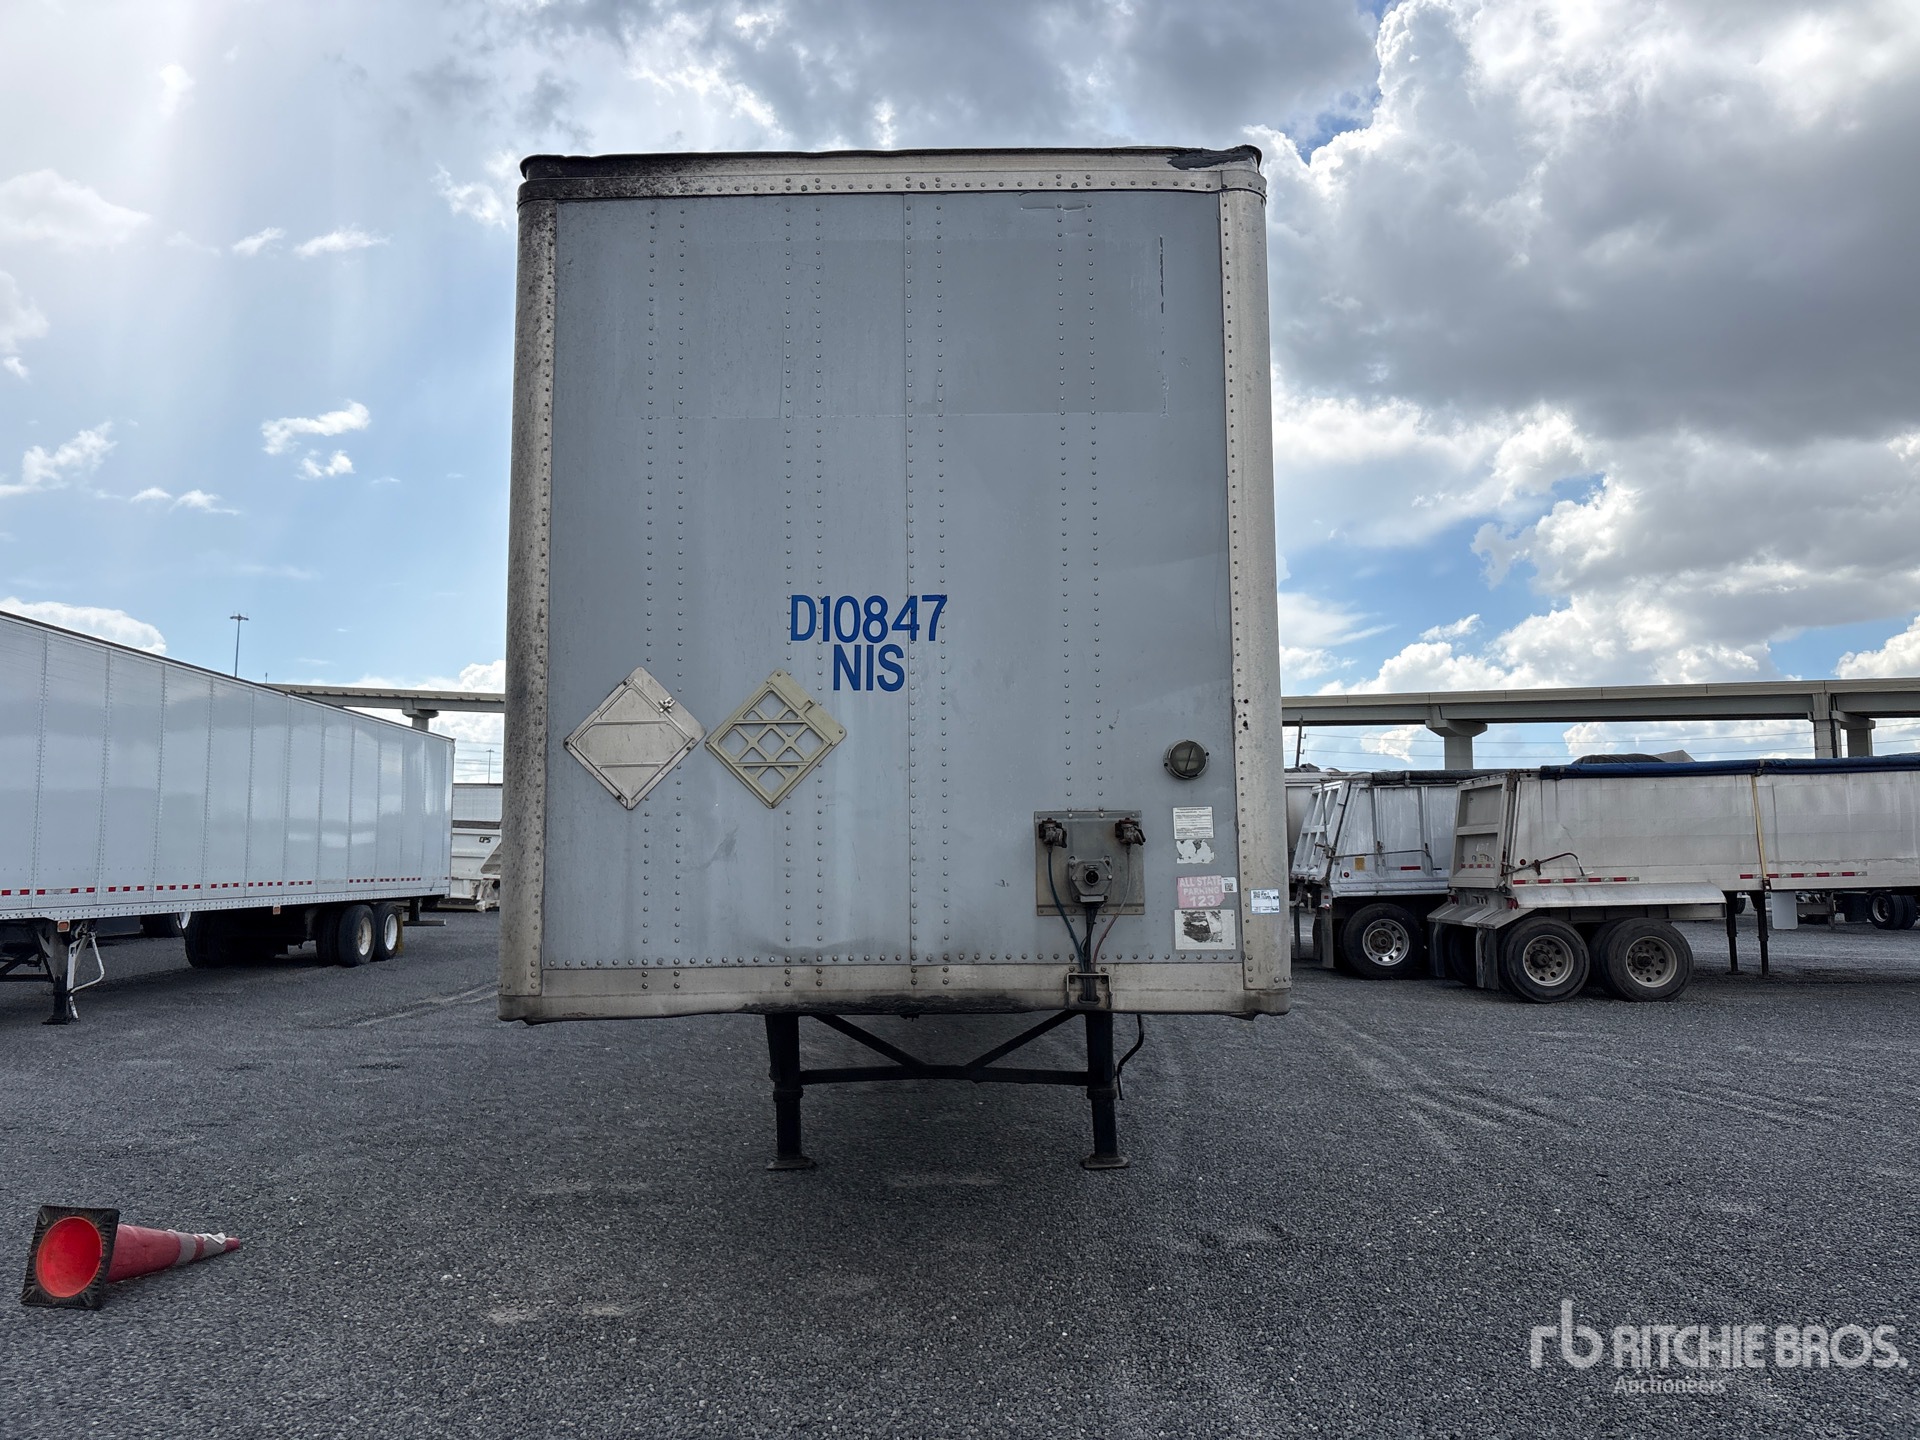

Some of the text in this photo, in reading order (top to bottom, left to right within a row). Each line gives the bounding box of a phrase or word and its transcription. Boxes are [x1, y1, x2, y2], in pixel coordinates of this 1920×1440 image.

[791, 594, 947, 643] D10847
[833, 643, 905, 692] NIS
[1180, 877, 1196, 887] ALL
[1183, 886, 1220, 895] PARKING
[1189, 895, 1216, 907] 123
